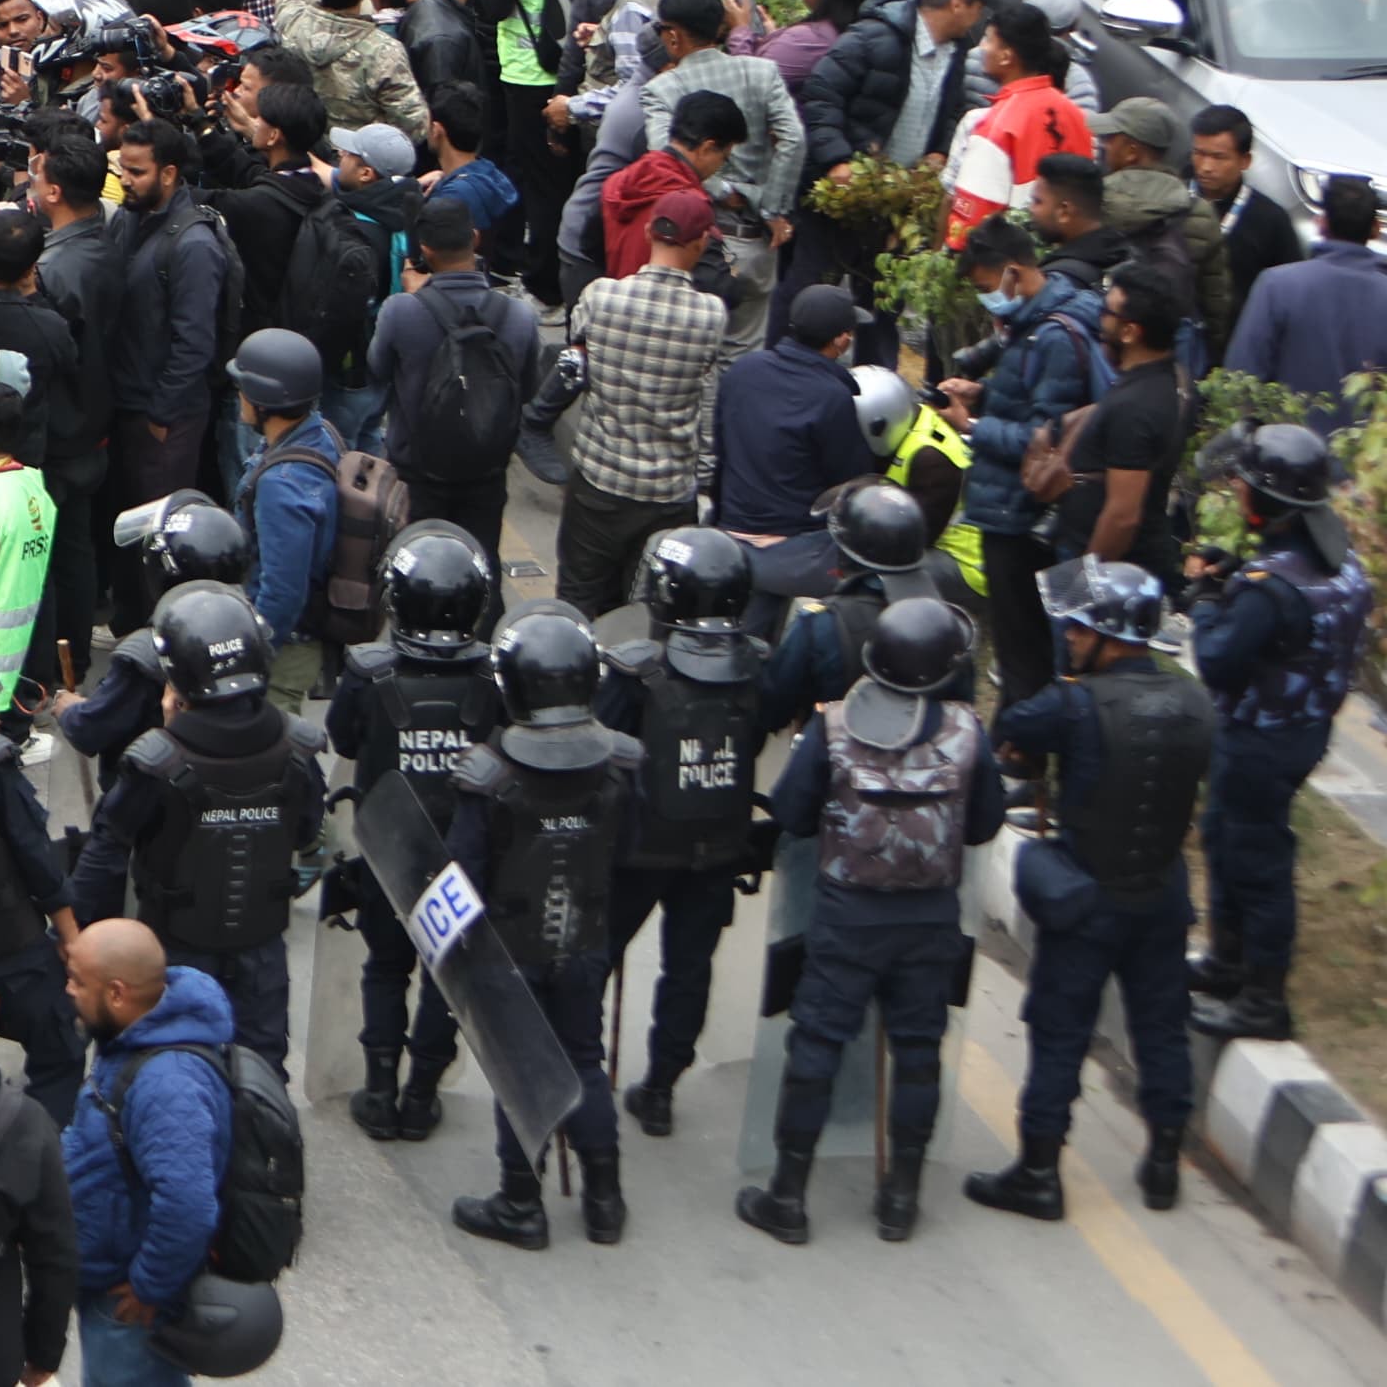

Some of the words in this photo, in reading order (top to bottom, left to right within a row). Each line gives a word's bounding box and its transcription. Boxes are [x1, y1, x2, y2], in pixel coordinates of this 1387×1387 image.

[208, 638, 244, 657] POLICE
[399, 729, 473, 749] NEPAL
[399, 753, 461, 772] POLIC
[202, 808, 237, 823] NEPAL
[239, 806, 279, 821] POLICE
[418, 873, 471, 950] ICE
